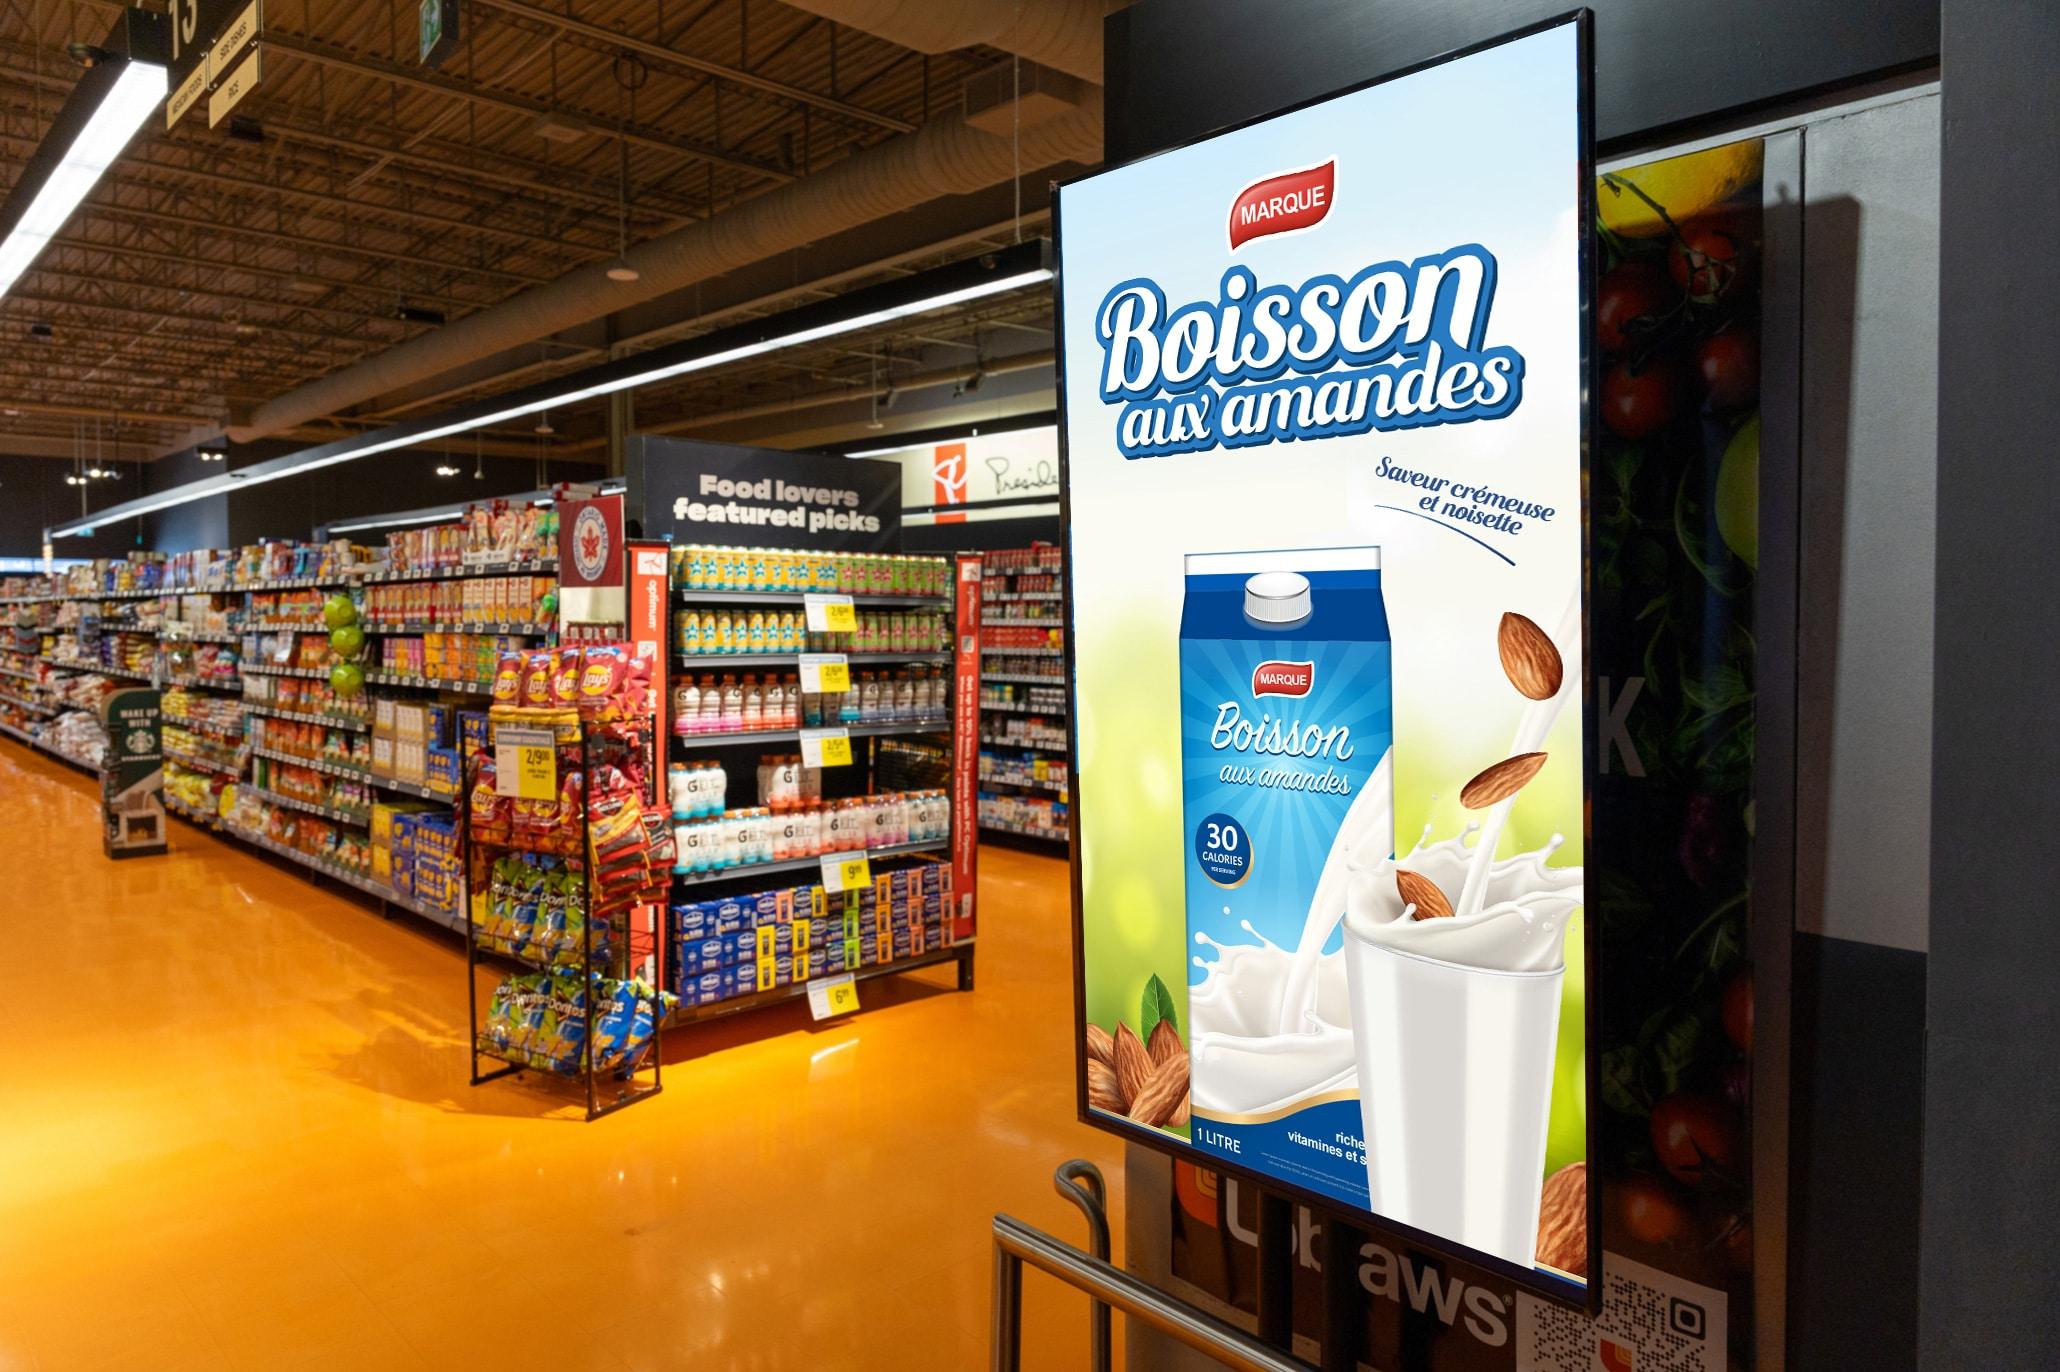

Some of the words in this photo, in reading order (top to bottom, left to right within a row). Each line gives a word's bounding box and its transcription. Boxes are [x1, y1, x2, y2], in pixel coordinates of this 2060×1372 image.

[1240, 185, 1326, 225] MARQUE
[1100, 251, 1486, 395] Boisson
[1122, 395, 1213, 447] aux
[1221, 340, 1511, 436] amandes
[699, 474, 771, 501] Food
[775, 479, 860, 508] lovers
[1375, 456, 1451, 491] Saveur
[1450, 485, 1556, 522] crémeuse
[673, 497, 806, 528] featured
[809, 508, 880, 534] picks
[1419, 495, 1441, 512] et
[1441, 501, 1523, 535] noisette
[1260, 673, 1307, 686] MARQUE
[1211, 701, 1354, 761] Boisson
[1219, 764, 1256, 785] aux
[1258, 765, 1352, 796] amandes
[1207, 823, 1238, 851] 30
[1202, 851, 1243, 867] CALORIES
[1197, 1128, 1202, 1141] 1
[1206, 1130, 1241, 1154] LITRE
[1287, 1131, 1343, 1158] vitamines
[1346, 1151, 1358, 1163] et
[1335, 1132, 1366, 1151] riche
